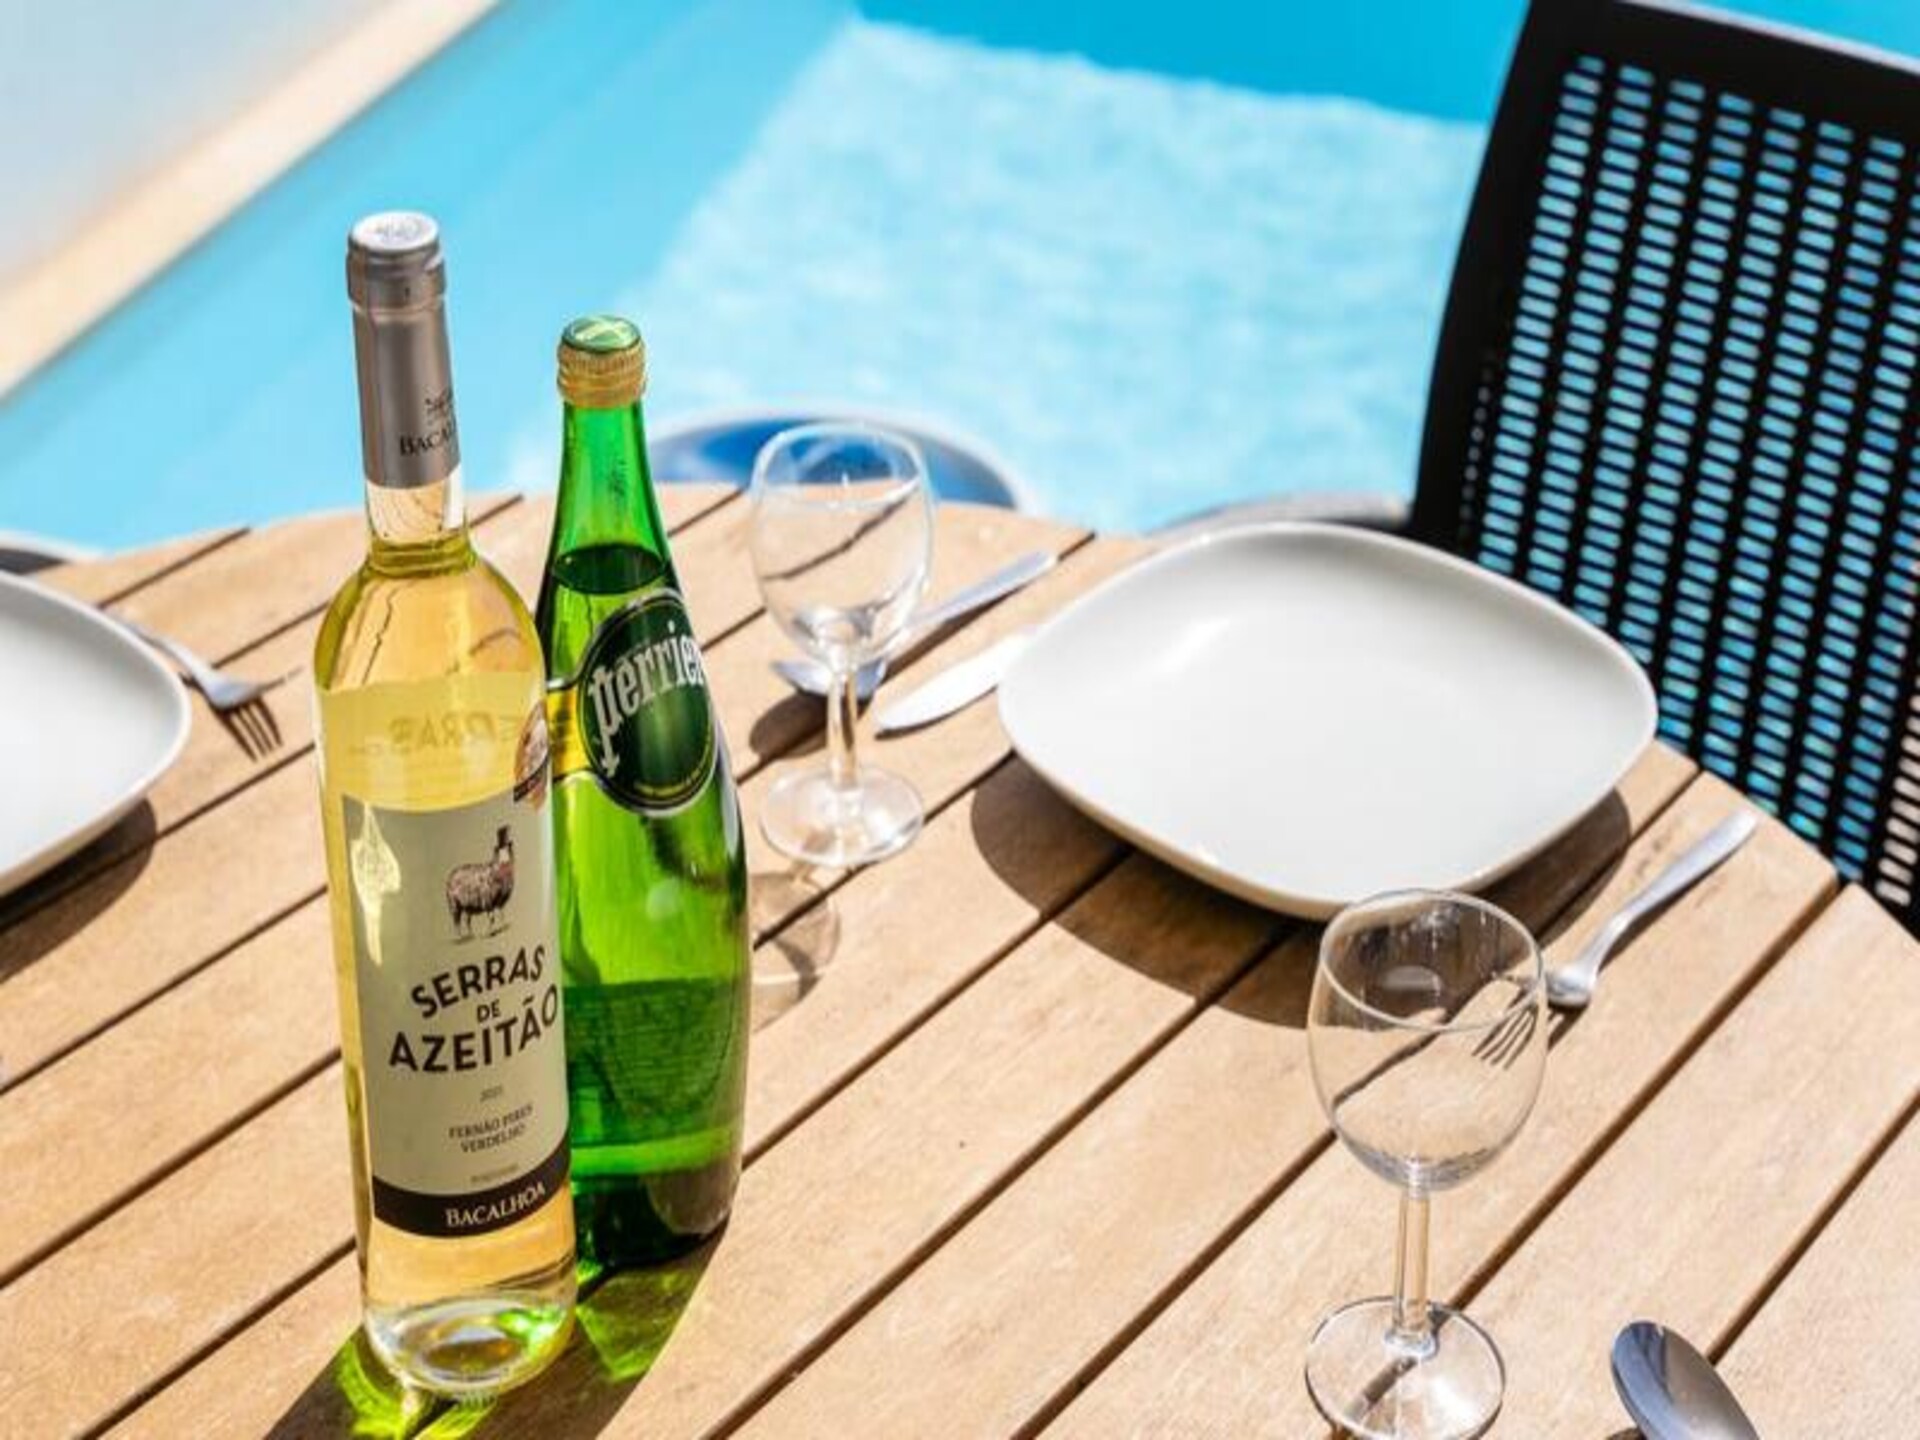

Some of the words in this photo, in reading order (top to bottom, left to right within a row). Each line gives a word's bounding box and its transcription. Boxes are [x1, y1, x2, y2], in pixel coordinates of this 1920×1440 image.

[411, 945, 546, 1020] SERRAS
[477, 1000, 500, 1023] DE
[389, 983, 558, 1073] AZEITÃO
